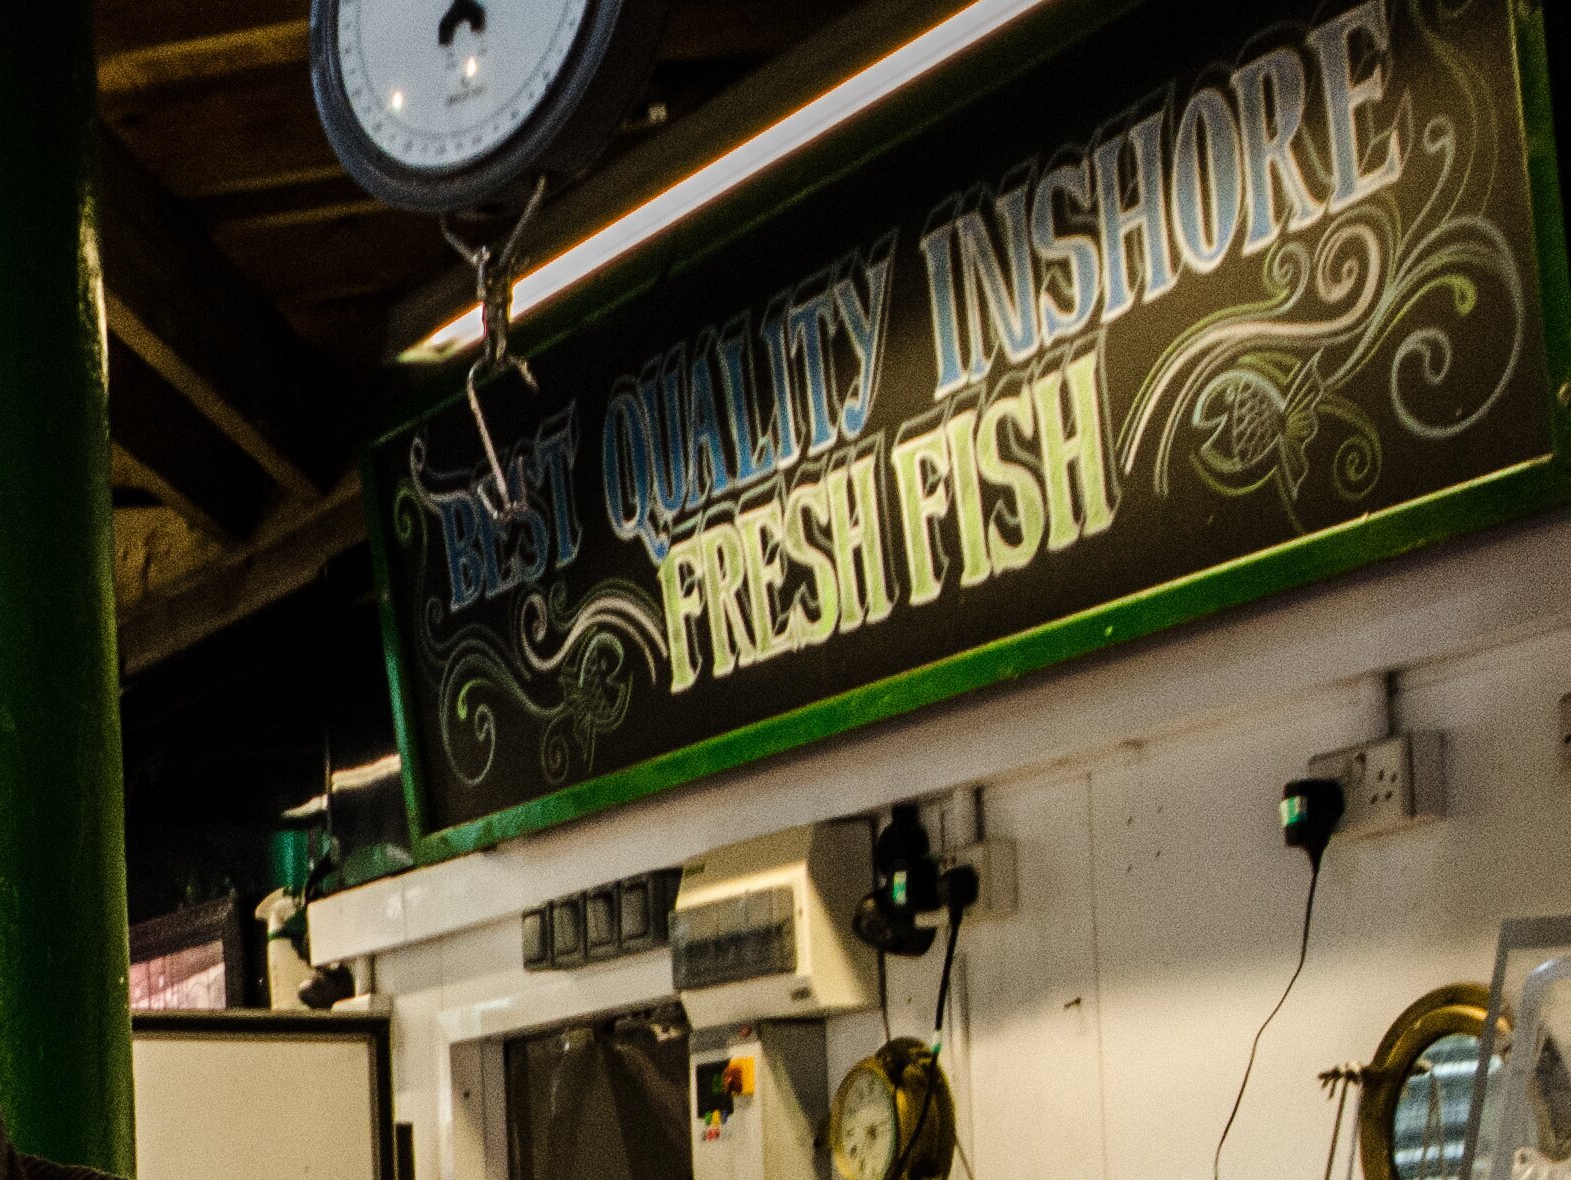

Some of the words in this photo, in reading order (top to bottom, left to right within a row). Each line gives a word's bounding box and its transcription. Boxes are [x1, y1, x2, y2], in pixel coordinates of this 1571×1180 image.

[430, 408, 581, 612] BEST
[603, 240, 895, 562] QUALITY
[919, 3, 1404, 400] INSHORE
[658, 452, 887, 694] FRESH
[892, 350, 1116, 606] FISH
